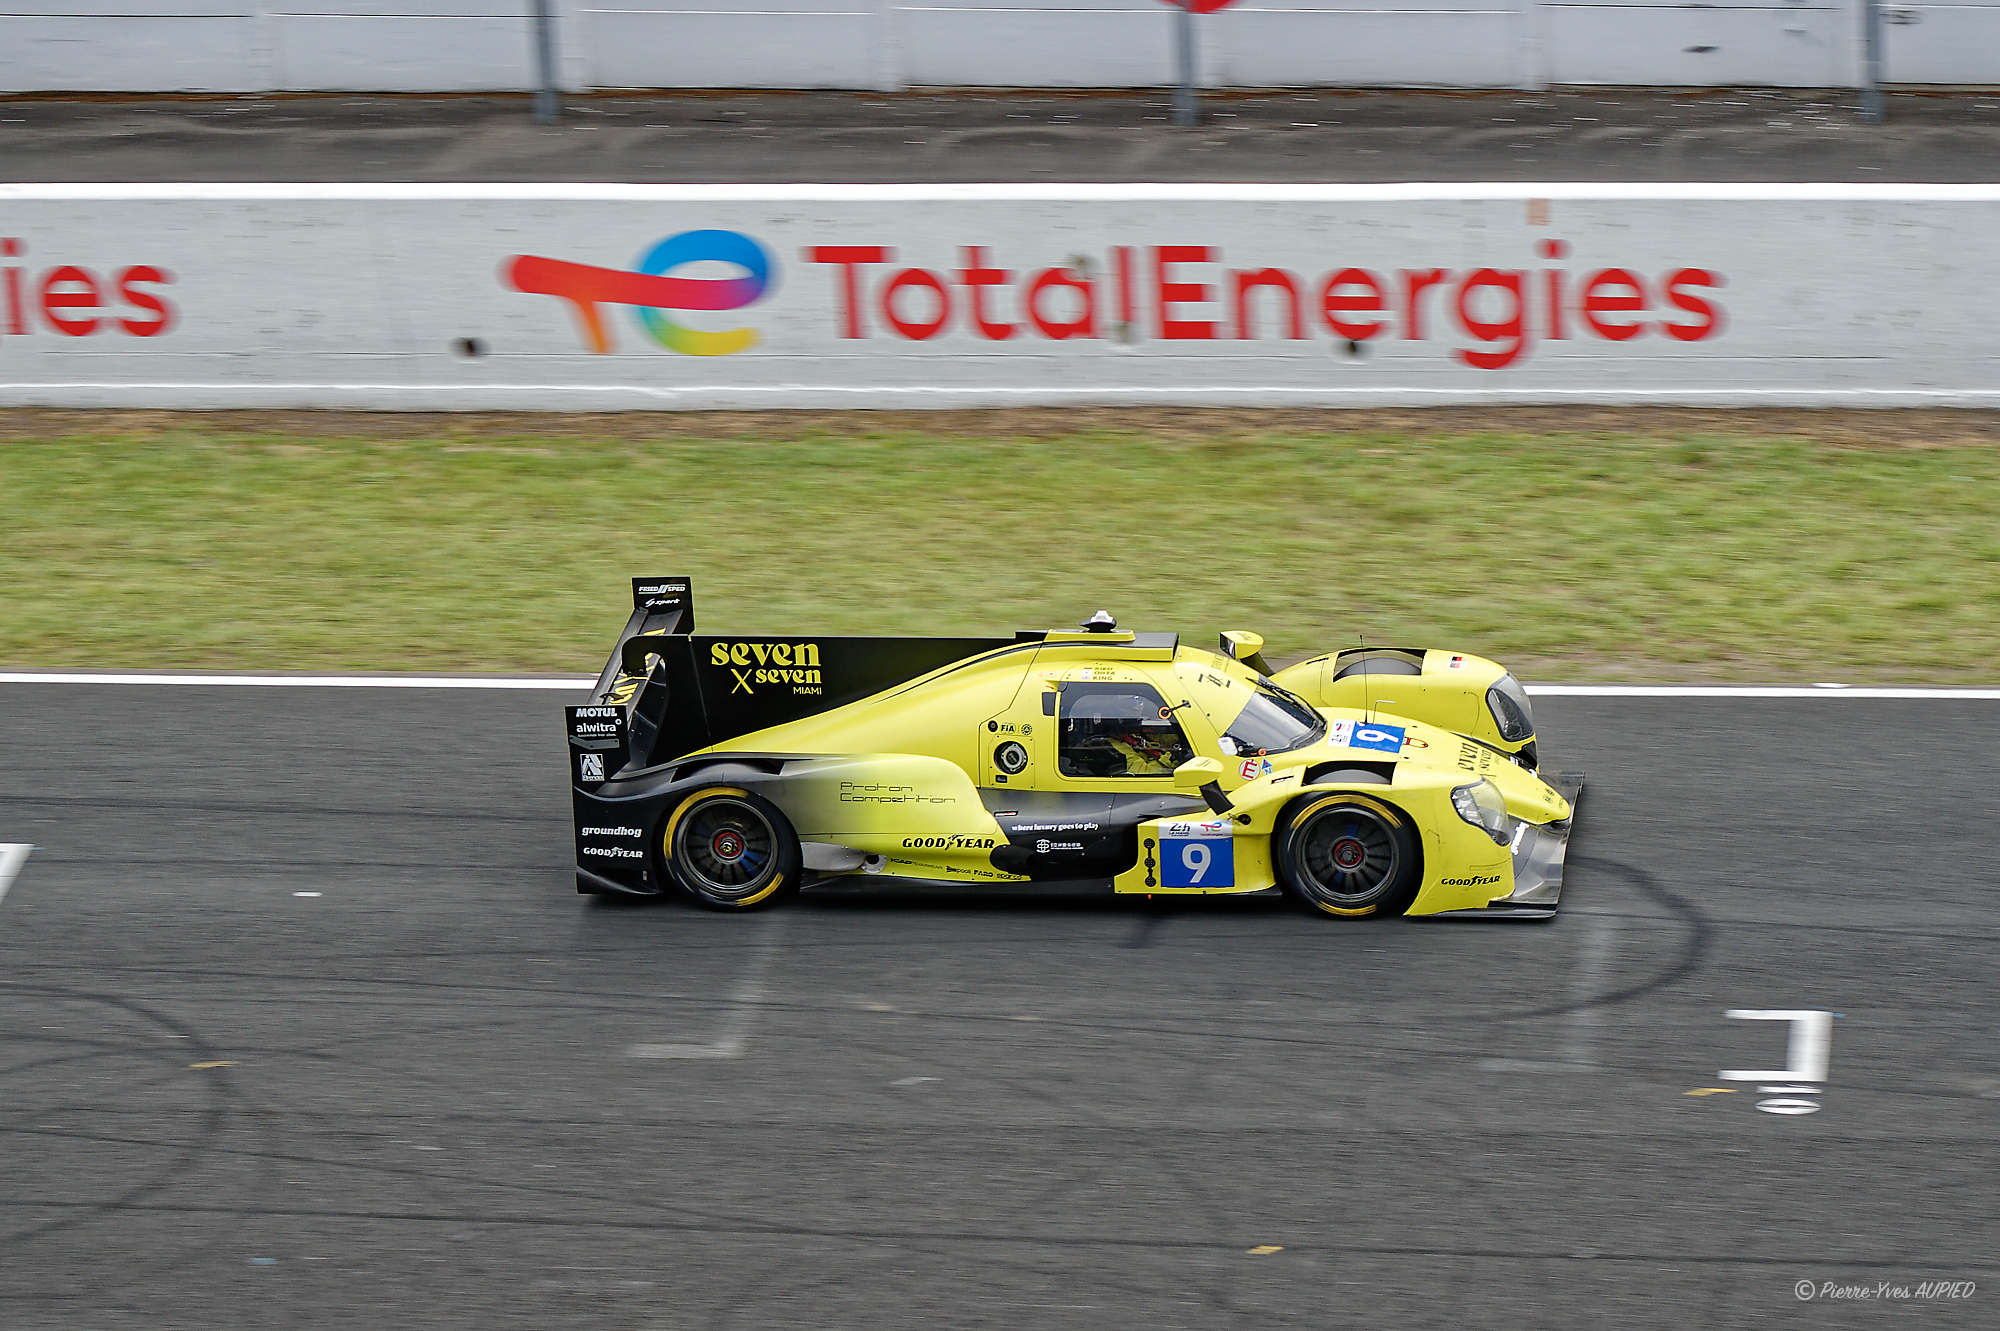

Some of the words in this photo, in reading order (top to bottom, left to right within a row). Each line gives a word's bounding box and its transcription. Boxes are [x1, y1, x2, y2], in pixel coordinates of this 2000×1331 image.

[808, 239, 1724, 369] TotalEnergies
[711, 643, 822, 666] seven
[755, 669, 822, 684] seven
[793, 686, 822, 695] MIAMI
[576, 708, 618, 718] MOTUL
[576, 722, 617, 733] alwitra
[840, 782, 913, 792] Proton
[581, 826, 642, 838] groundhog
[1181, 843, 1212, 884] 9
